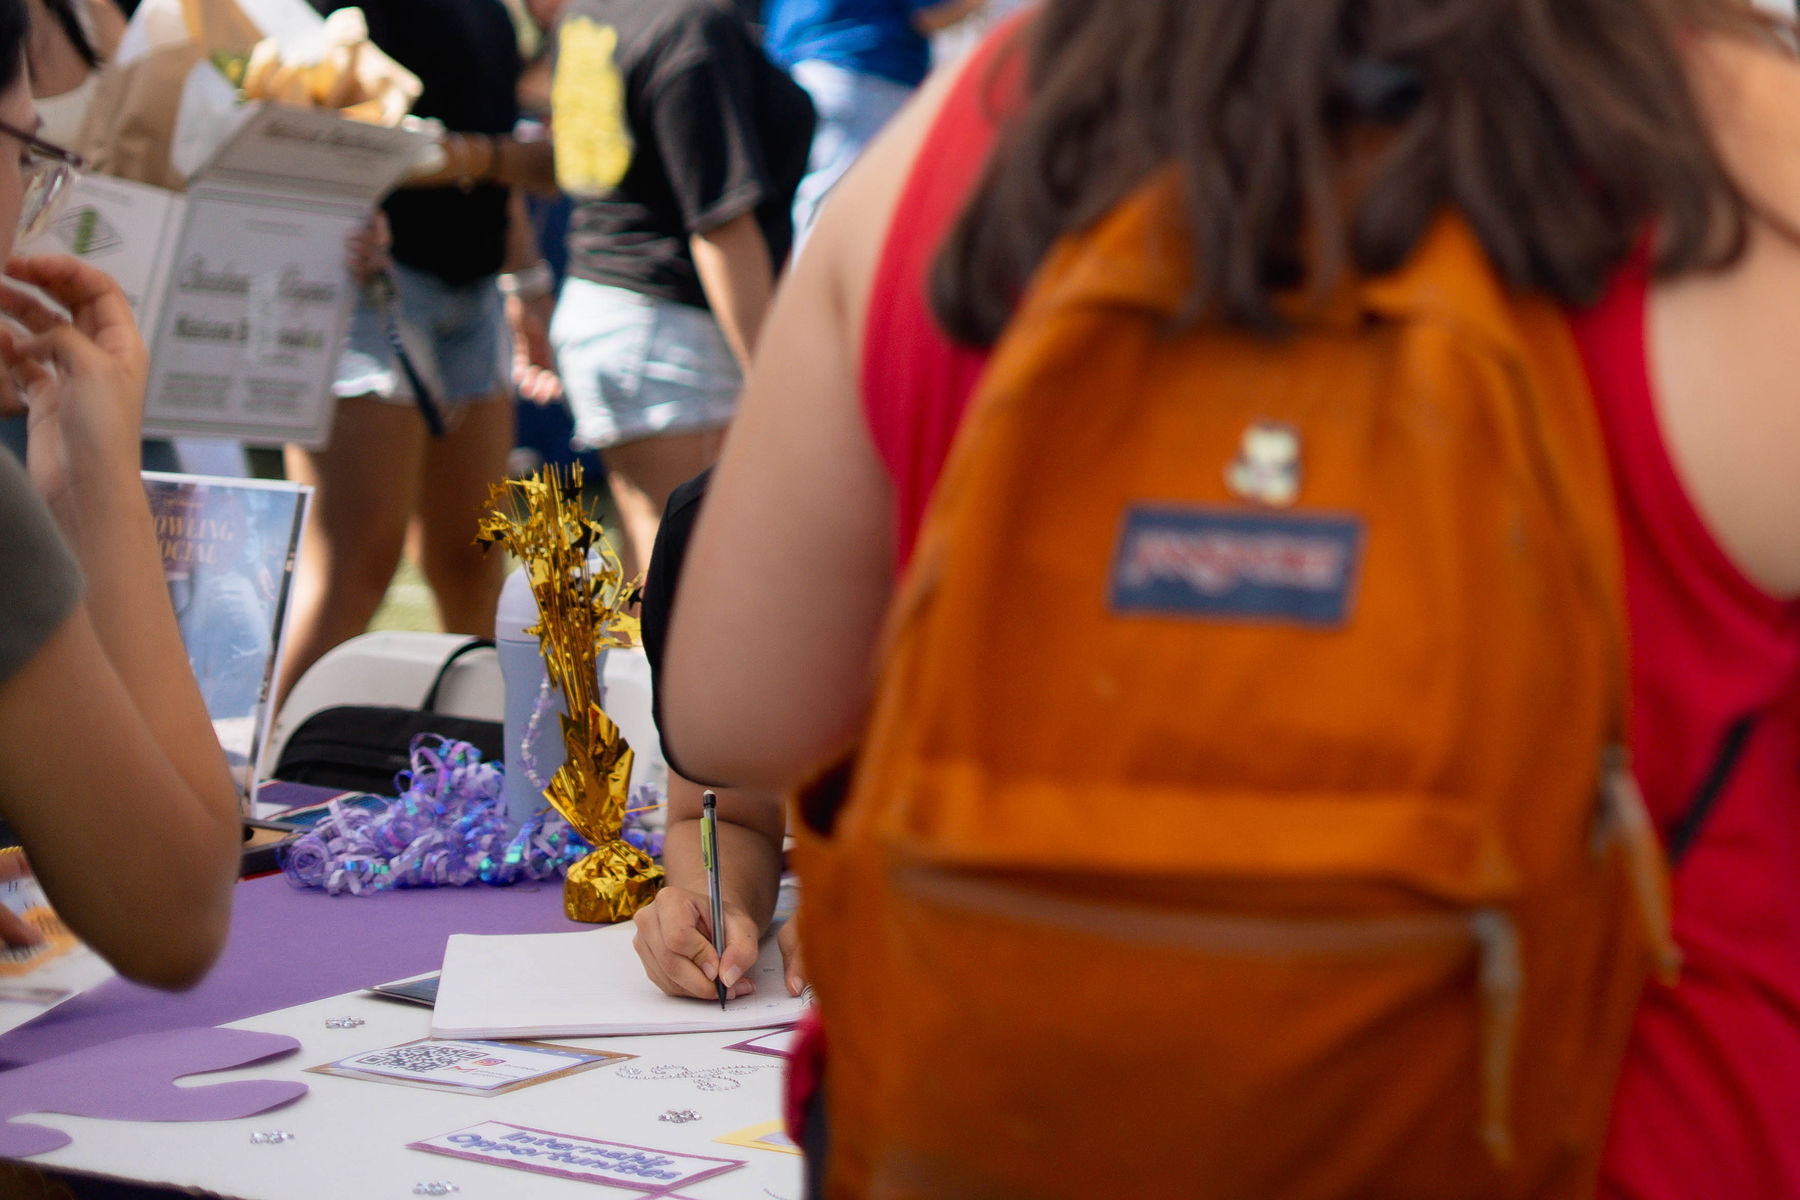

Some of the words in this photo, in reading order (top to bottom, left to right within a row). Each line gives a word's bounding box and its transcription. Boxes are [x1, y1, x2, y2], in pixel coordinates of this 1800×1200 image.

[153, 514, 234, 542] OWLING
[159, 538, 217, 565] OCIAL
[446, 1133, 683, 1181] Opportunities
[499, 1131, 676, 1170] Internship
